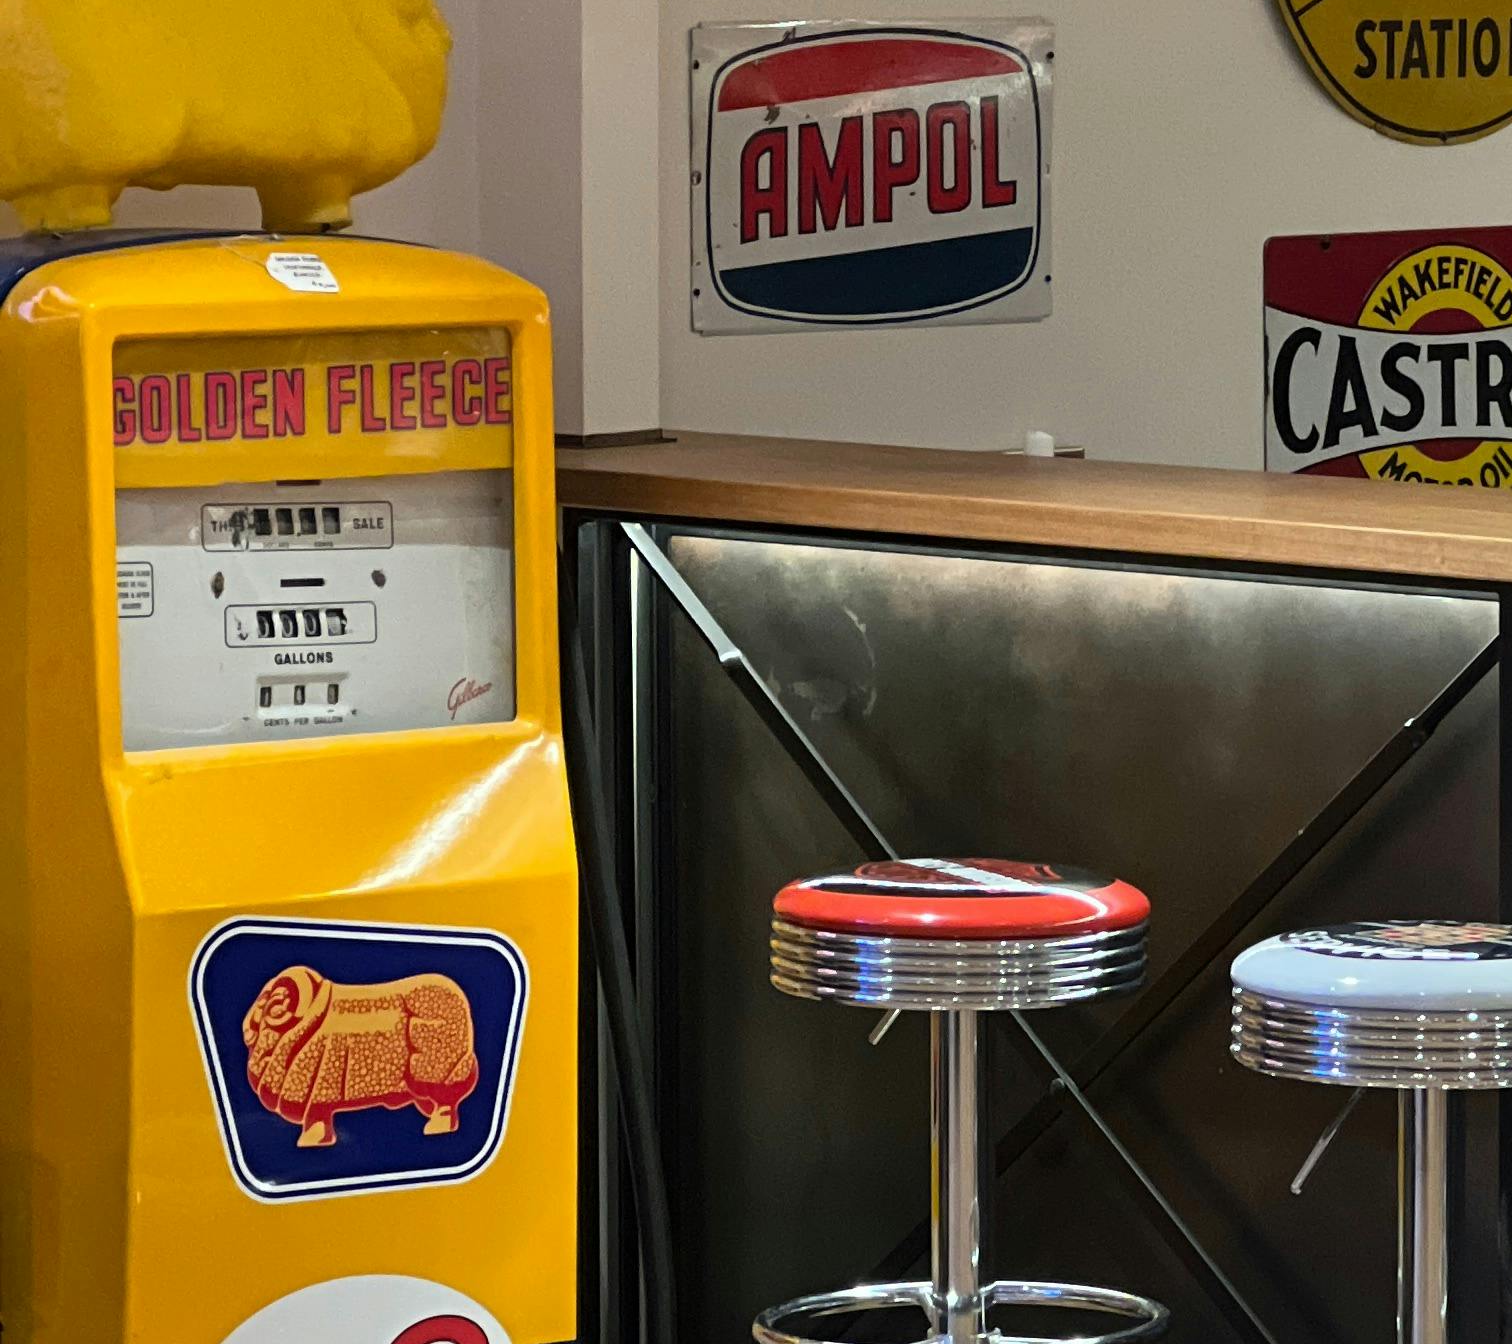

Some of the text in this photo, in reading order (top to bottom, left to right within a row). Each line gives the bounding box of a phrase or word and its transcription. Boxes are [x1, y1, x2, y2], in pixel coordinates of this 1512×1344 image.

[739, 94, 1018, 245] AMPOL
[113, 357, 512, 446] GOLDEN FLEECE
[352, 517, 385, 530] SALE
[274, 651, 334, 665] GALLONS
[263, 716, 290, 727] CENTS
[294, 716, 310, 725] PER
